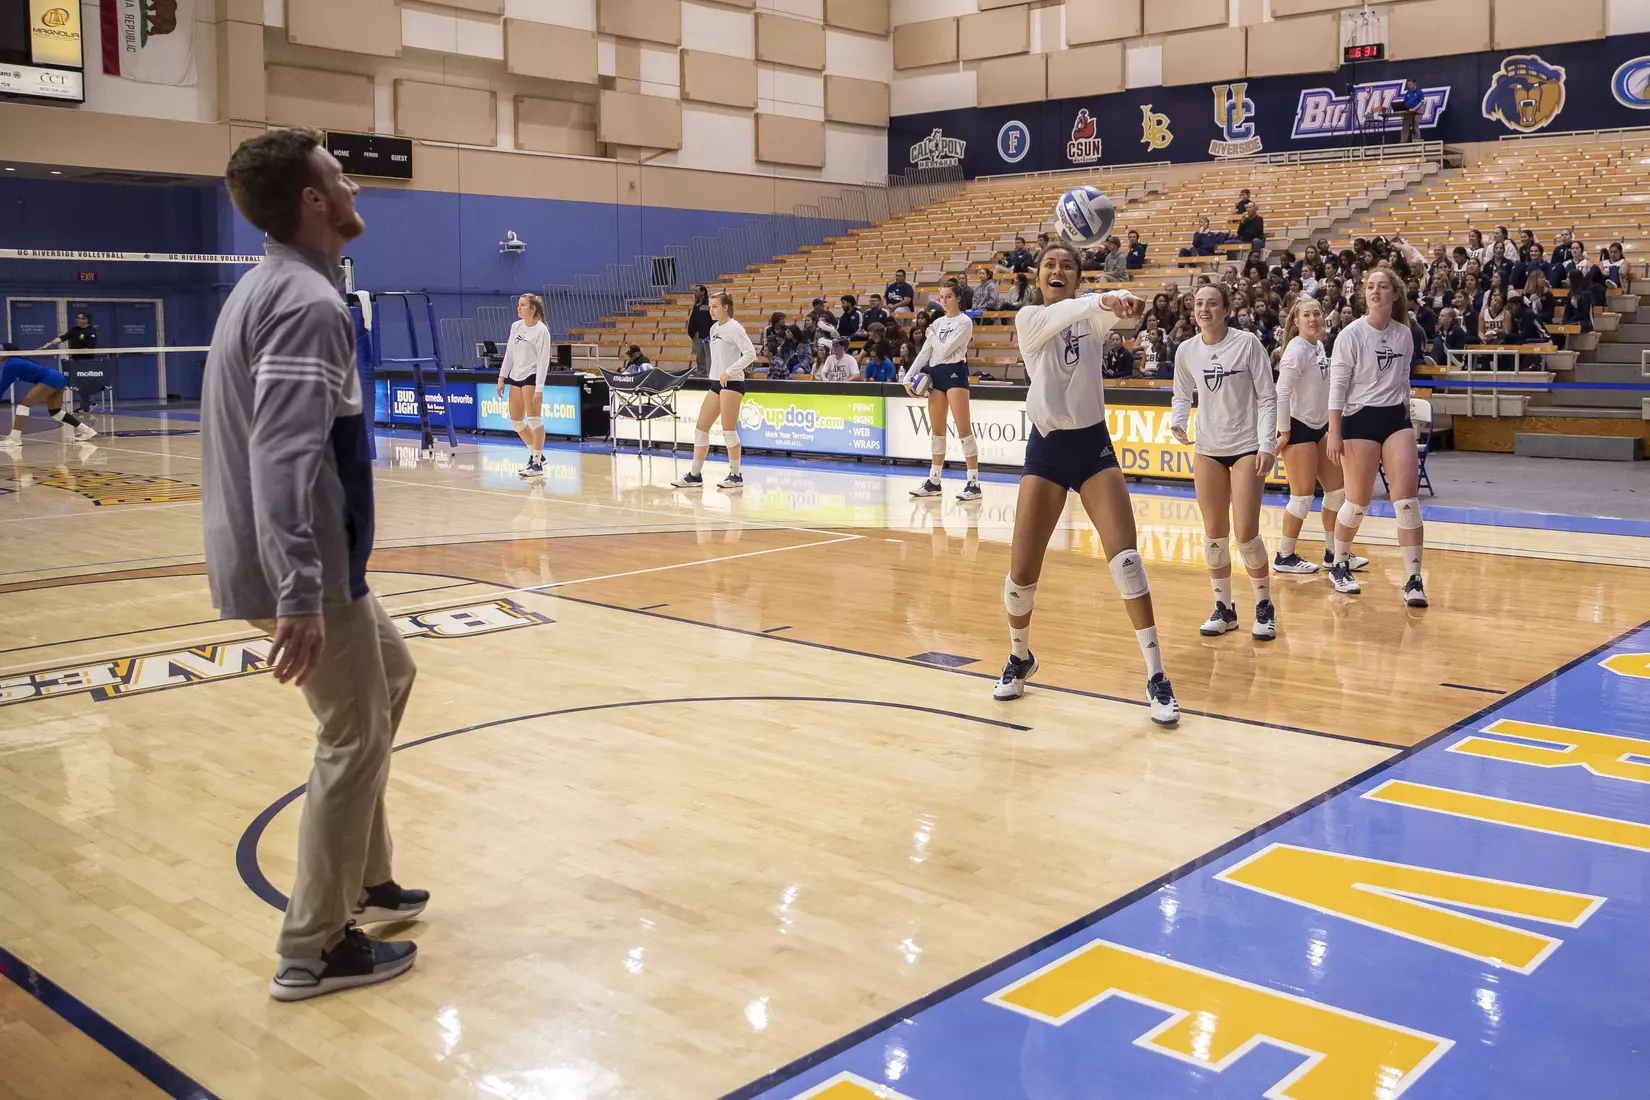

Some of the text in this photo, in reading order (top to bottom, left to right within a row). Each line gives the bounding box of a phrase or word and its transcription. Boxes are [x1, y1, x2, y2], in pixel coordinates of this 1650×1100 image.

[124, 14, 136, 53] REPUBLIC
[39, 72, 68, 85] CCT
[1212, 82, 1255, 141] UC
[1300, 94, 1348, 130] BIG
[1008, 130, 1020, 154] F
[1209, 137, 1262, 155] RIVERSIDE
[911, 138, 966, 161] CAL POLY
[1067, 140, 1101, 158] CSUN
[390, 154, 408, 162] GUEST
[77, 251, 125, 259] VOLLEYBALL
[80, 272, 95, 280] EXIT
[1483, 320, 1504, 330] CBU
[396, 390, 415, 402] BUD
[451, 393, 474, 404] favorite
[394, 402, 419, 415] LIGHT
[853, 403, 875, 413] PRINT
[765, 404, 844, 430] updog.com
[853, 415, 874, 425] SIGNS
[765, 430, 815, 442] Mark Your Territory
[853, 427, 871, 437] WEB
[853, 440, 881, 450] WRAPS
